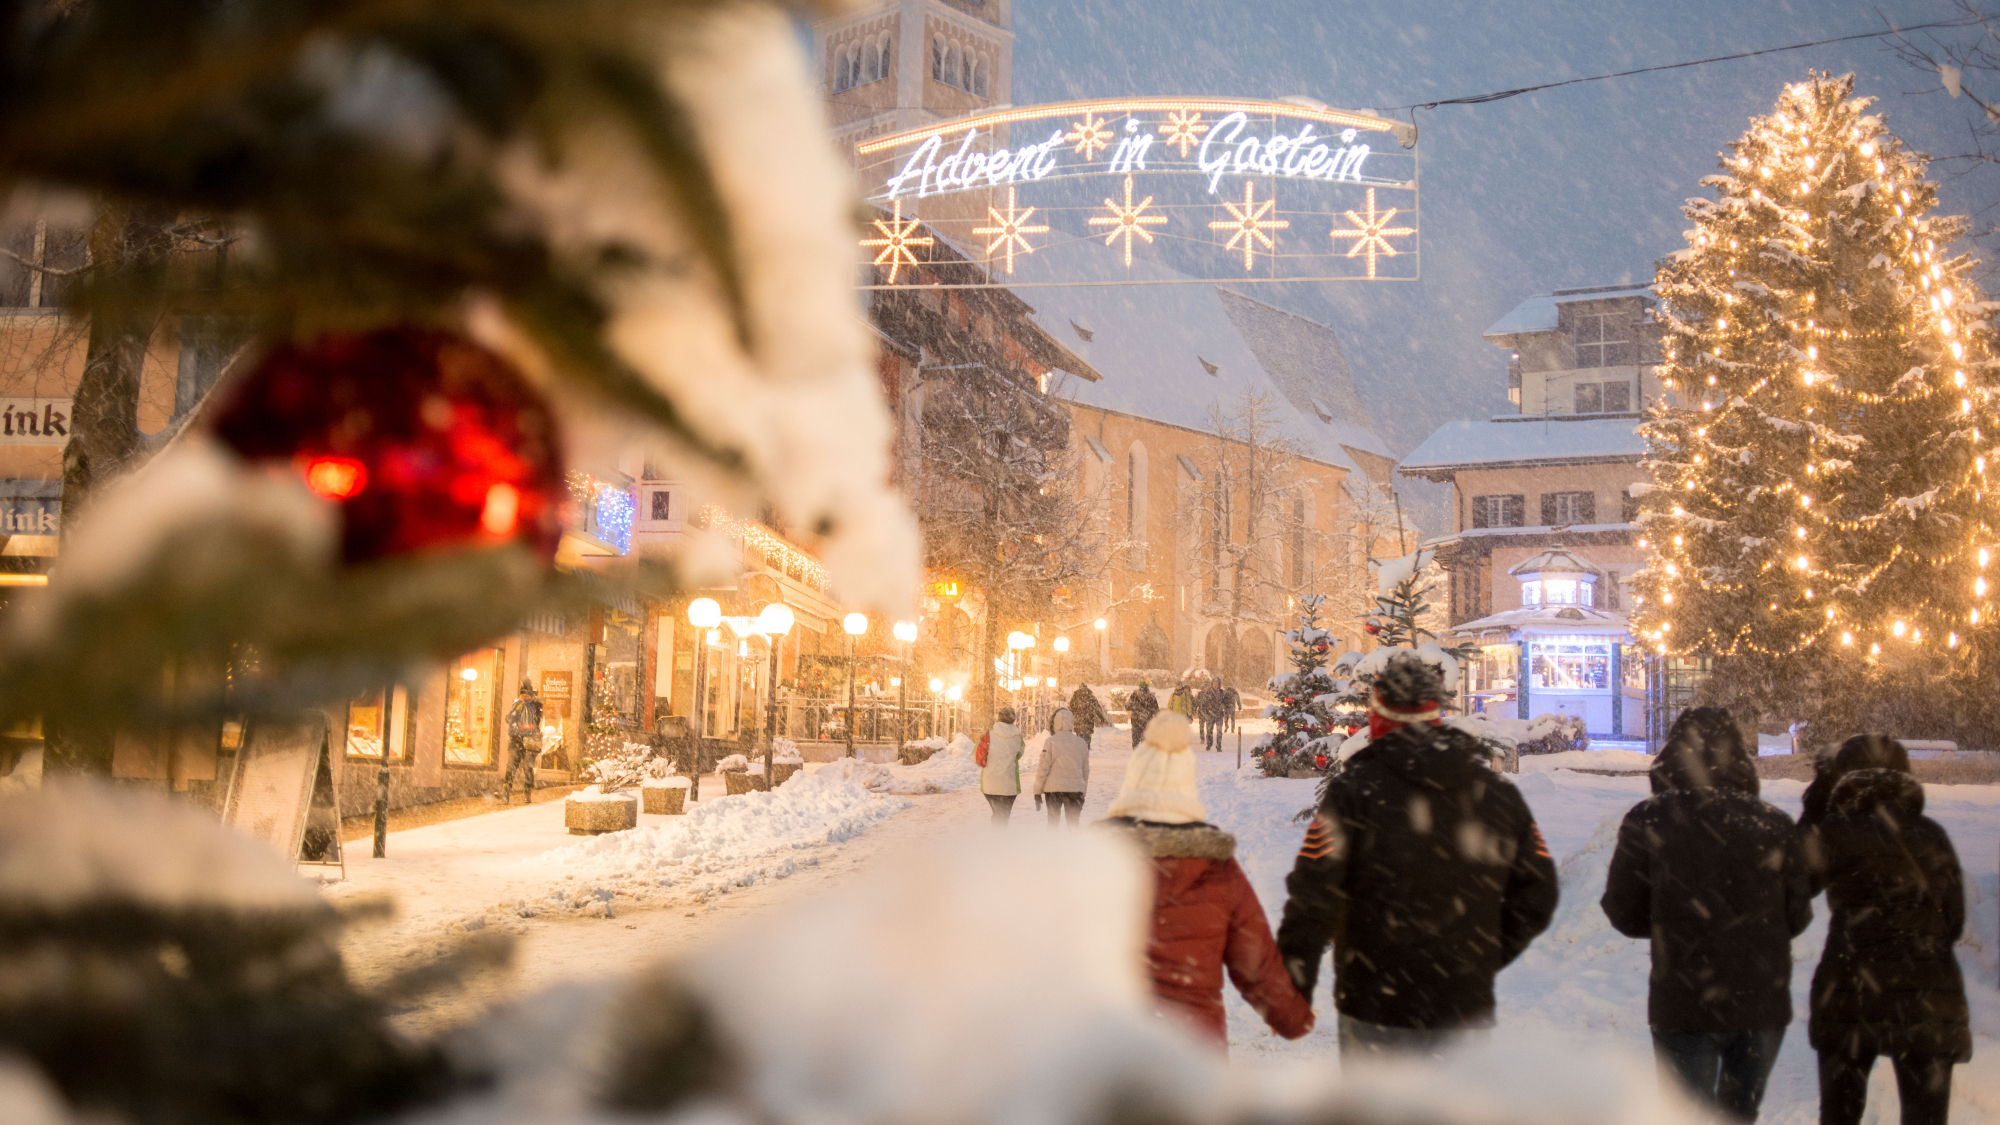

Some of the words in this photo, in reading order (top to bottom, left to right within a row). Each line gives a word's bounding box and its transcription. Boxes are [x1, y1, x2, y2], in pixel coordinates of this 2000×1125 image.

[887, 128, 1065, 199] Advent
[1109, 118, 1153, 173] in
[1199, 111, 1370, 194] Gastein
